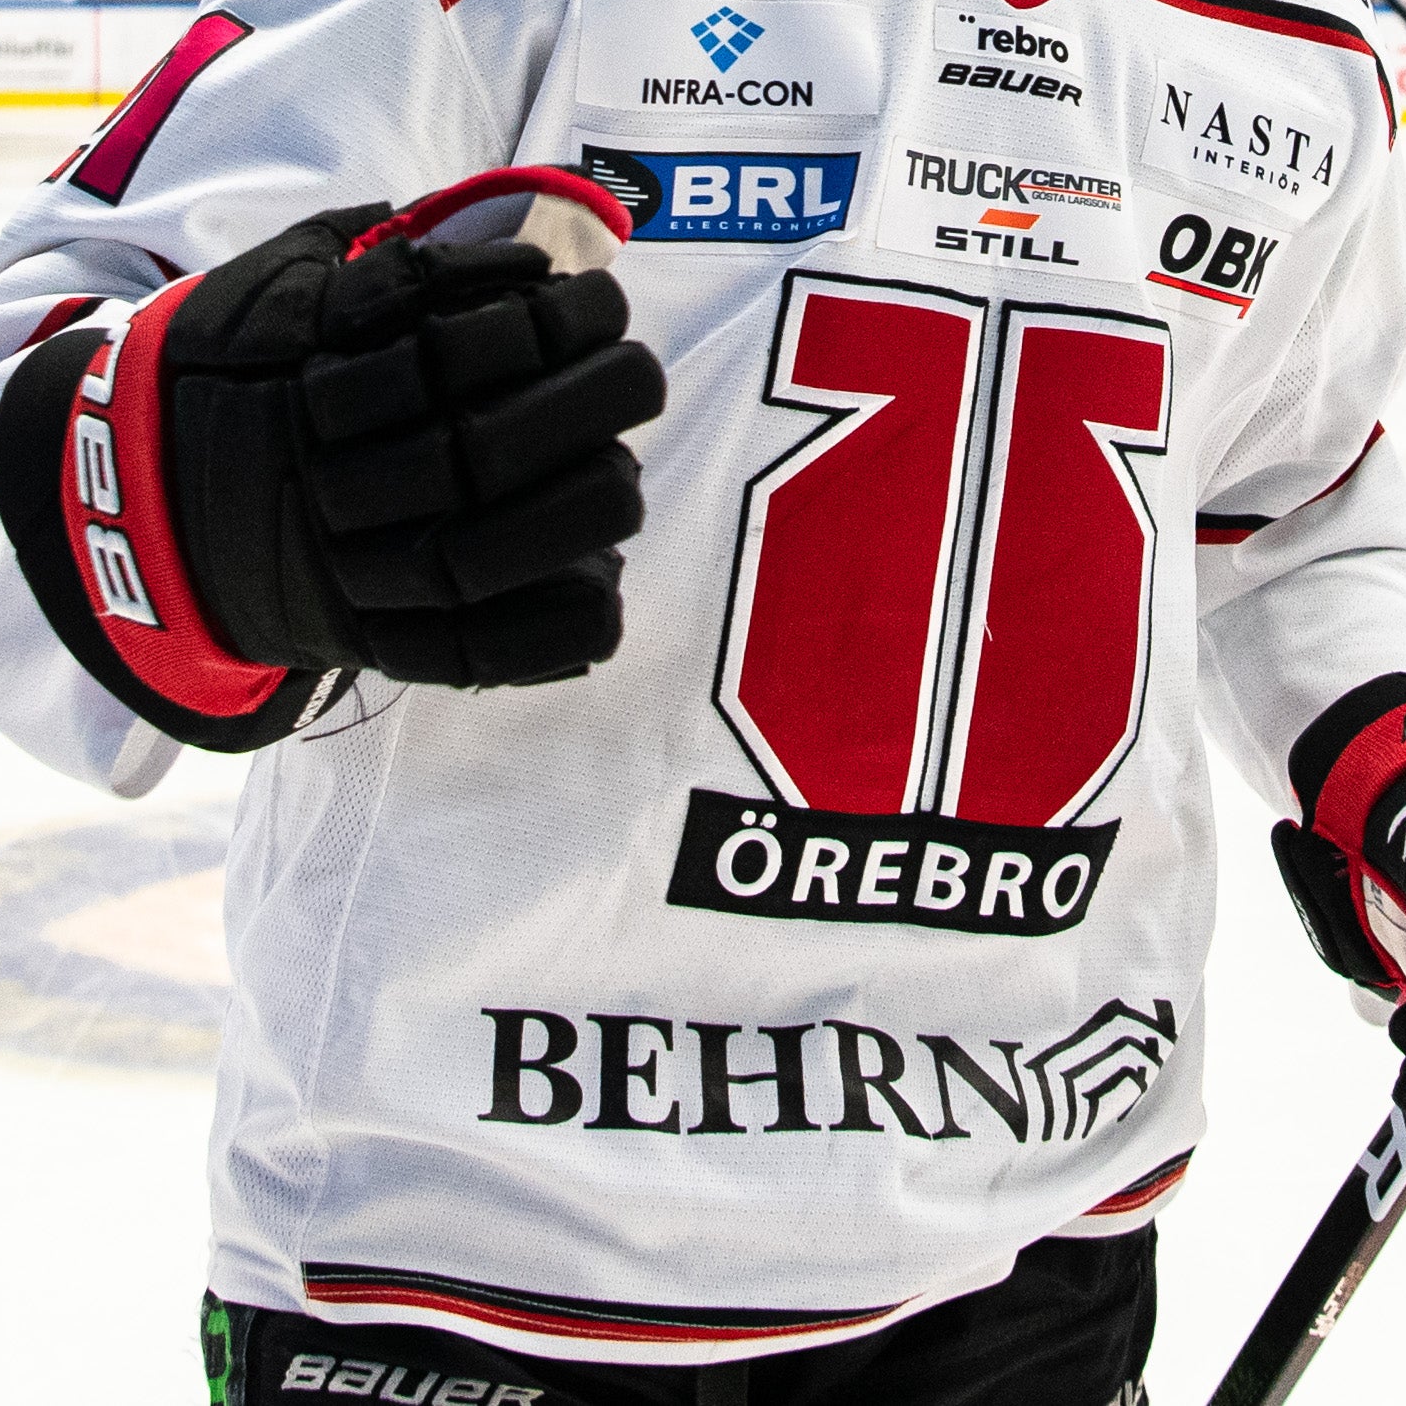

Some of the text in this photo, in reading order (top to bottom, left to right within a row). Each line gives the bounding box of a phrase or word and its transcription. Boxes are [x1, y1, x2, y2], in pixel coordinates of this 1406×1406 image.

[641, 78, 814, 108] INFRA-CON
[938, 63, 1083, 107] BAUER
[1159, 82, 1335, 187] NASTA
[671, 164, 842, 219] BRL
[1192, 146, 1300, 196] INTERIÖR
[670, 214, 839, 232] ELECTRONICS
[935, 225, 1080, 266] STILL
[1159, 213, 1280, 295] OBK
[716, 810, 1092, 919] ÖREBRO
[478, 1007, 1026, 1144] BEHRN
[281, 1353, 545, 1406] BAUER
